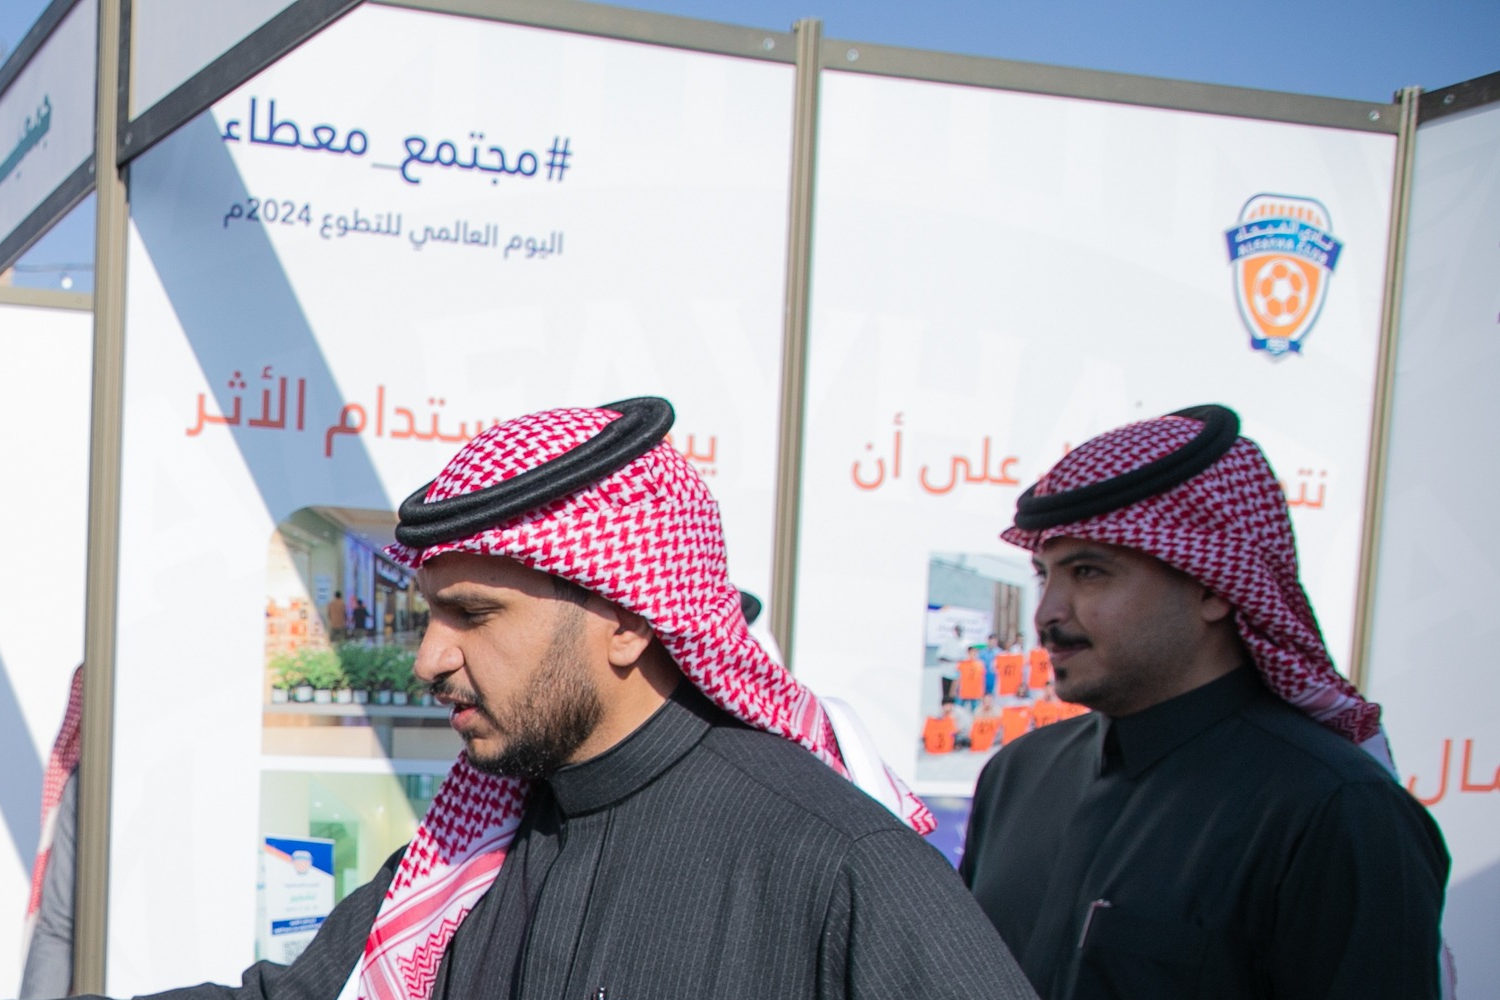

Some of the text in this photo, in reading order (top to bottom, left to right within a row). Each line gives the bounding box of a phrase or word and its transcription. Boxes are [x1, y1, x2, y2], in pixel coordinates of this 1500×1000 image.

[222, 96, 573, 185] #مجتمع_معطاء
[223, 197, 564, 260] اليوم العالمي للتطوع 2024م
[324, 385, 500, 457] ستدام
[852, 411, 905, 491] أن
[919, 436, 1020, 495] على
